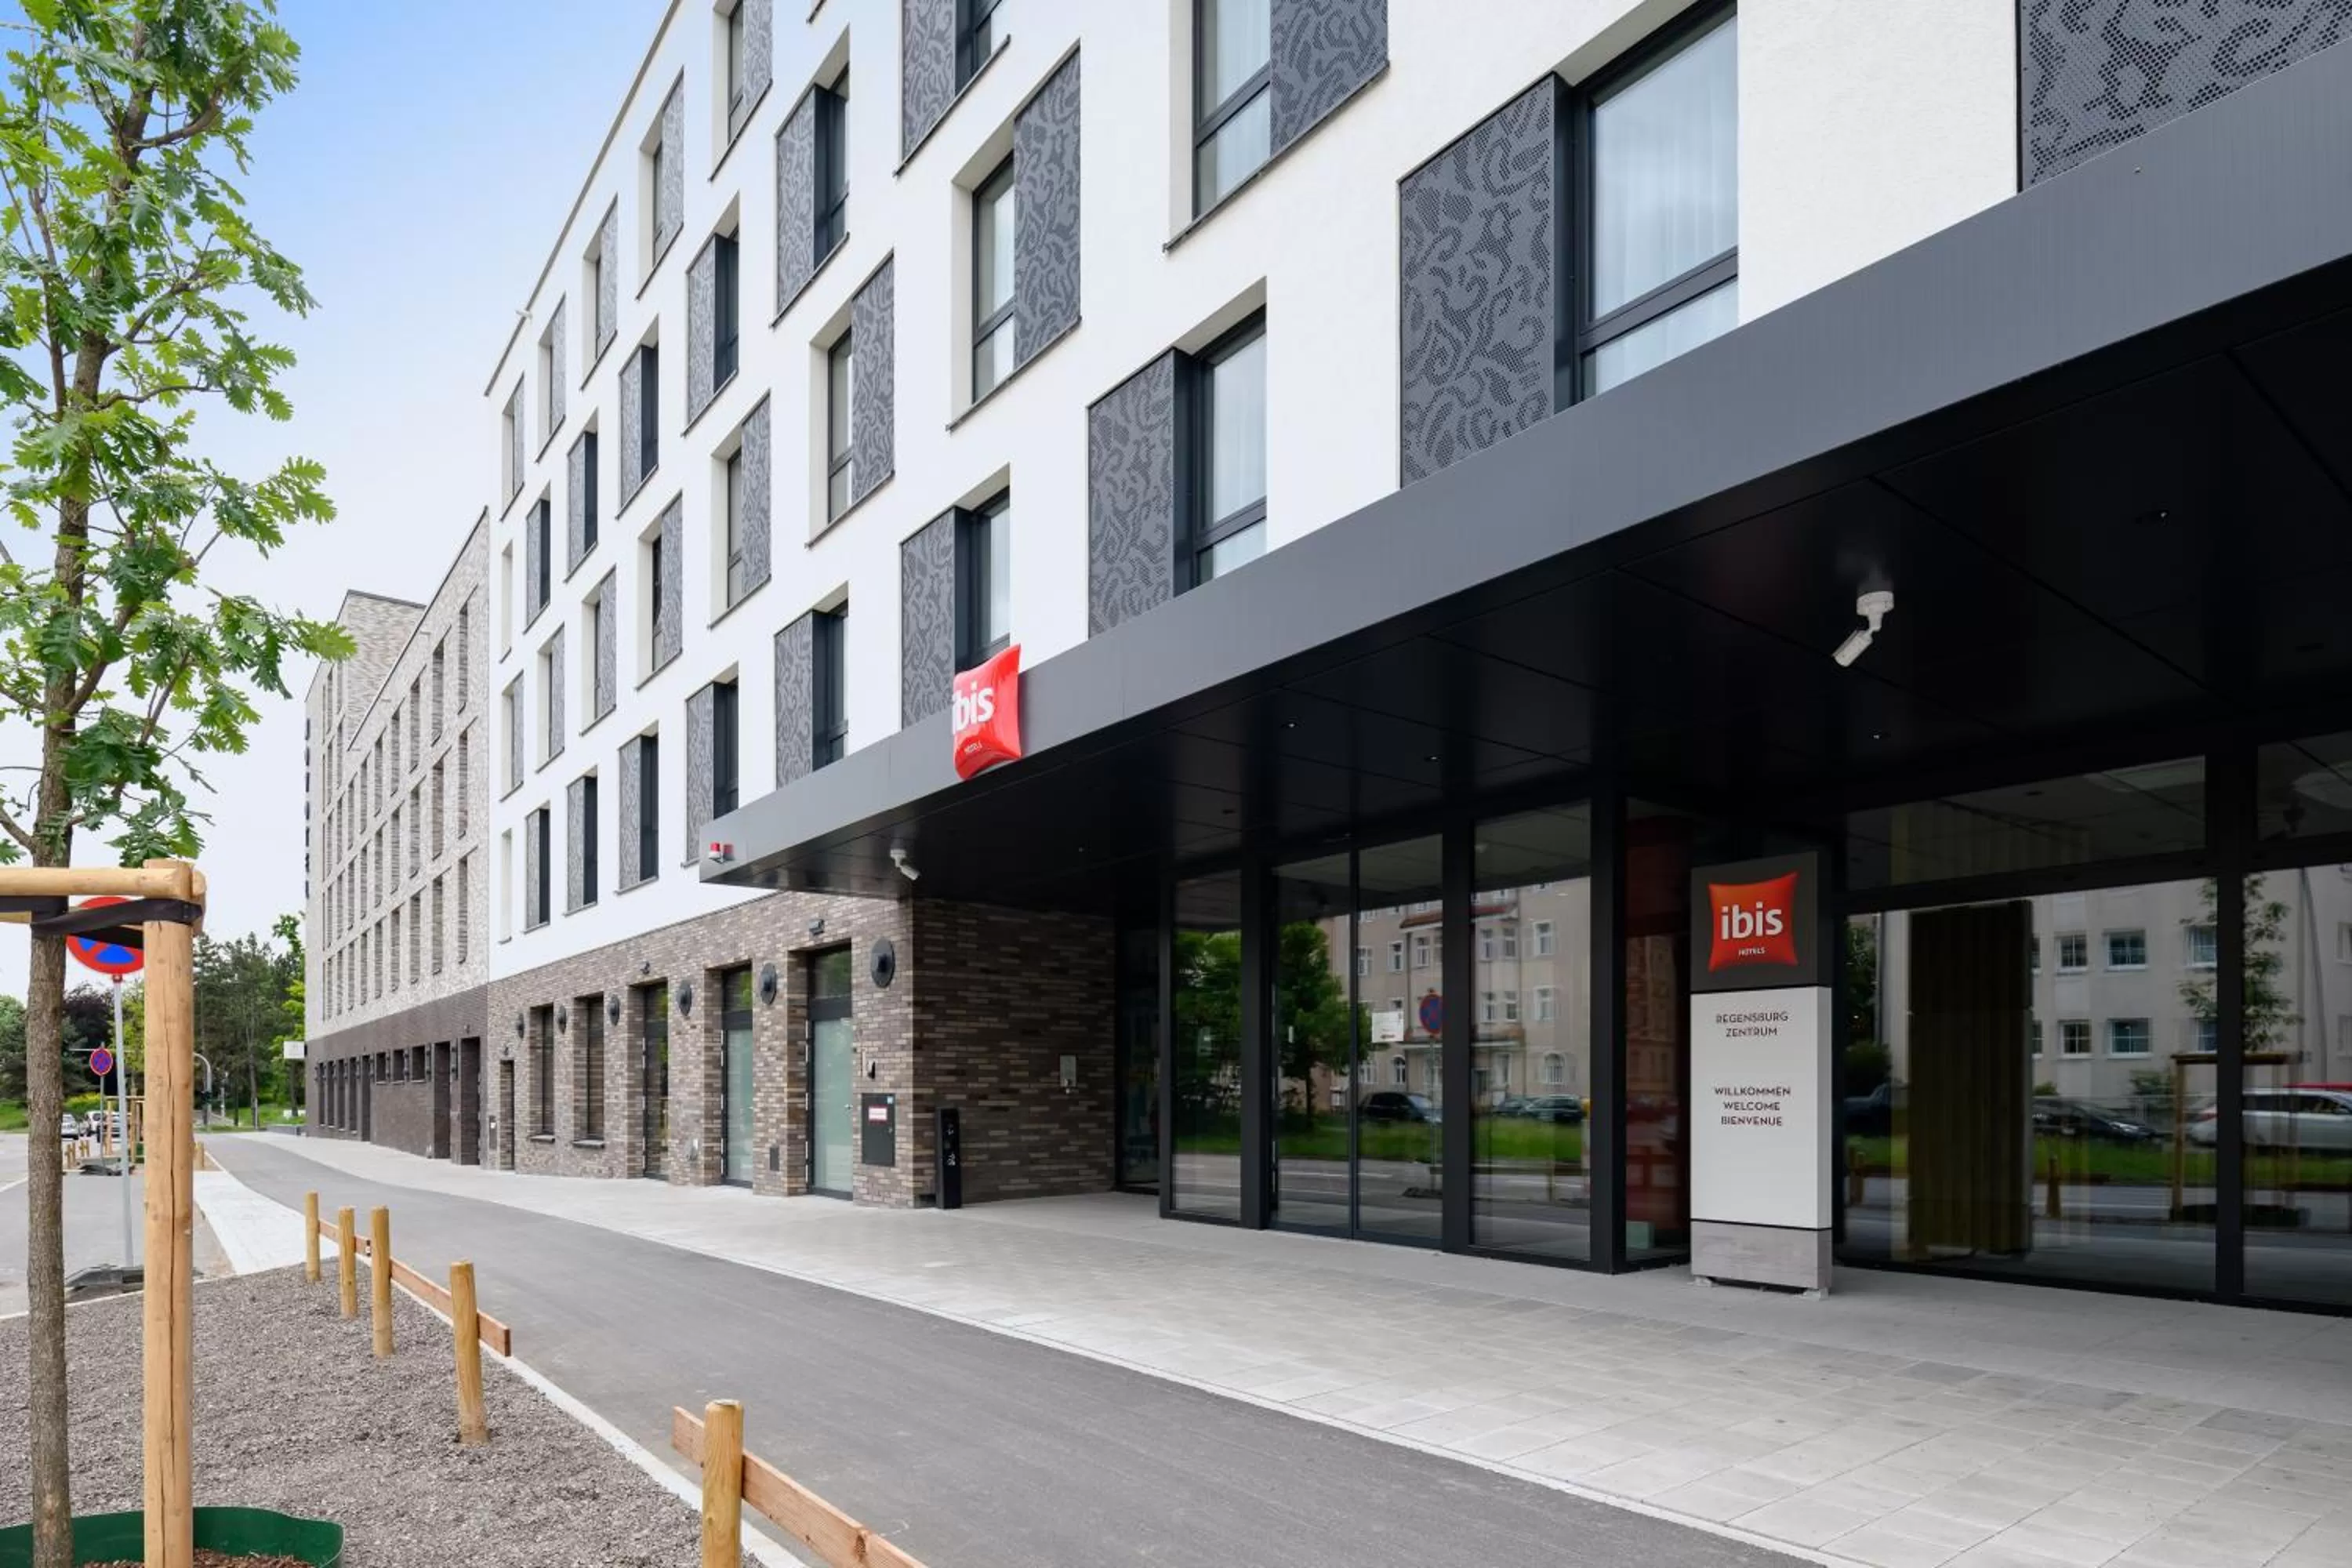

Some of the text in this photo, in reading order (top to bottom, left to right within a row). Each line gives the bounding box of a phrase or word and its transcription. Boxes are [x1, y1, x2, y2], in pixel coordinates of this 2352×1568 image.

[1722, 902, 1783, 940] ibis
[1738, 947, 1766, 956] HOTELS
[1715, 1011, 1788, 1023] REGENSBURG
[1726, 1027, 1777, 1037] ZENTRUM
[1715, 1087, 1791, 1096] WILLKOMMEN
[1723, 1102, 1780, 1111] WELCOME
[1721, 1116, 1782, 1127] BIENVENUE
